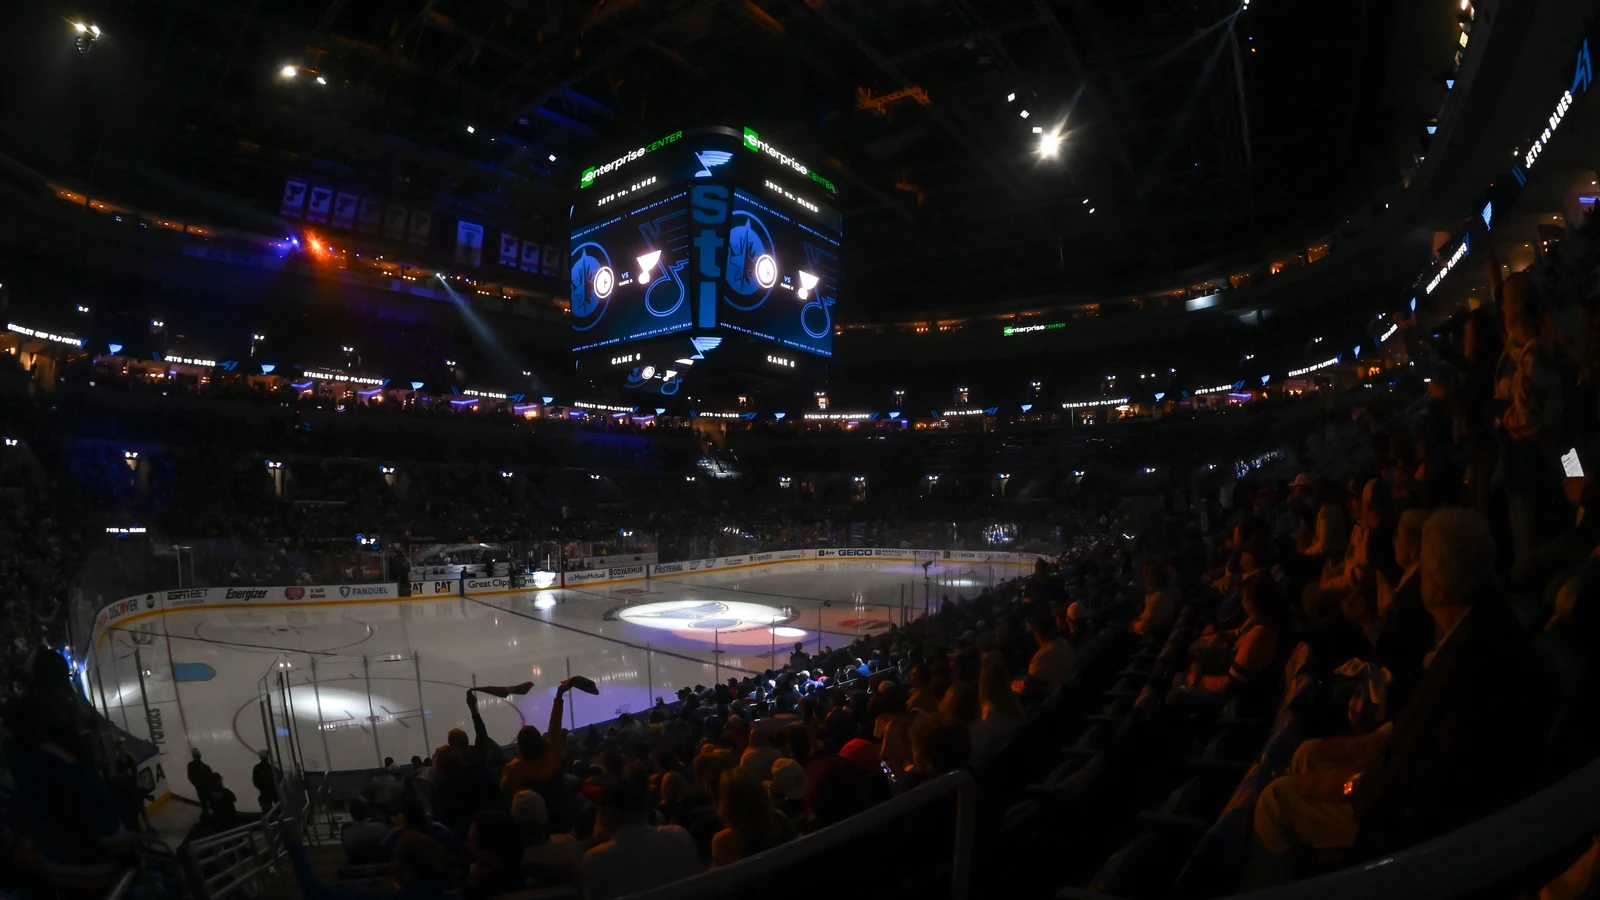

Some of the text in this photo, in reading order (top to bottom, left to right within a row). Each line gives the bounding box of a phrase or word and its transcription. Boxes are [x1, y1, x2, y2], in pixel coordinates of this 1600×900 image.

[1525, 140, 1542, 169] JETS
[1549, 90, 1573, 130] BLUES
[581, 130, 683, 182] enterprise CENTER
[744, 134, 836, 191] enterprise CENTER
[597, 194, 615, 207] JETS
[631, 176, 657, 192] BLUES
[765, 179, 783, 194] JETS
[797, 197, 819, 213] BLUES
[7, 323, 34, 336] STANLEY
[34, 331, 49, 339] CUP
[1004, 325, 1045, 334] enterprise
[164, 355, 182, 363] JETS
[193, 358, 216, 367] BLUES
[611, 353, 641, 365] GAME 6
[767, 355, 795, 368] GAME 6
[303, 371, 333, 380] STANLEY
[350, 376, 383, 385] PLAYOFFS
[1288, 367, 1309, 377] STANLEY
[1216, 384, 1232, 392] BLUES
[574, 401, 596, 409] STANLEY
[1100, 398, 1127, 406] PLAYOFFS
[754, 554, 772, 562] Expedia
[838, 548, 873, 556] GEICO
[608, 566, 644, 578] BODYARMOR
[653, 563, 683, 574] FASTENAL
[574, 571, 606, 580] MassMutual
[434, 581, 452, 594] CAT
[468, 580, 491, 588] Great
[167, 588, 209, 601] ESPN BET
[225, 587, 268, 602] Energizer
[352, 586, 388, 596] FANDUEL
[108, 599, 139, 620] DISCOVER
